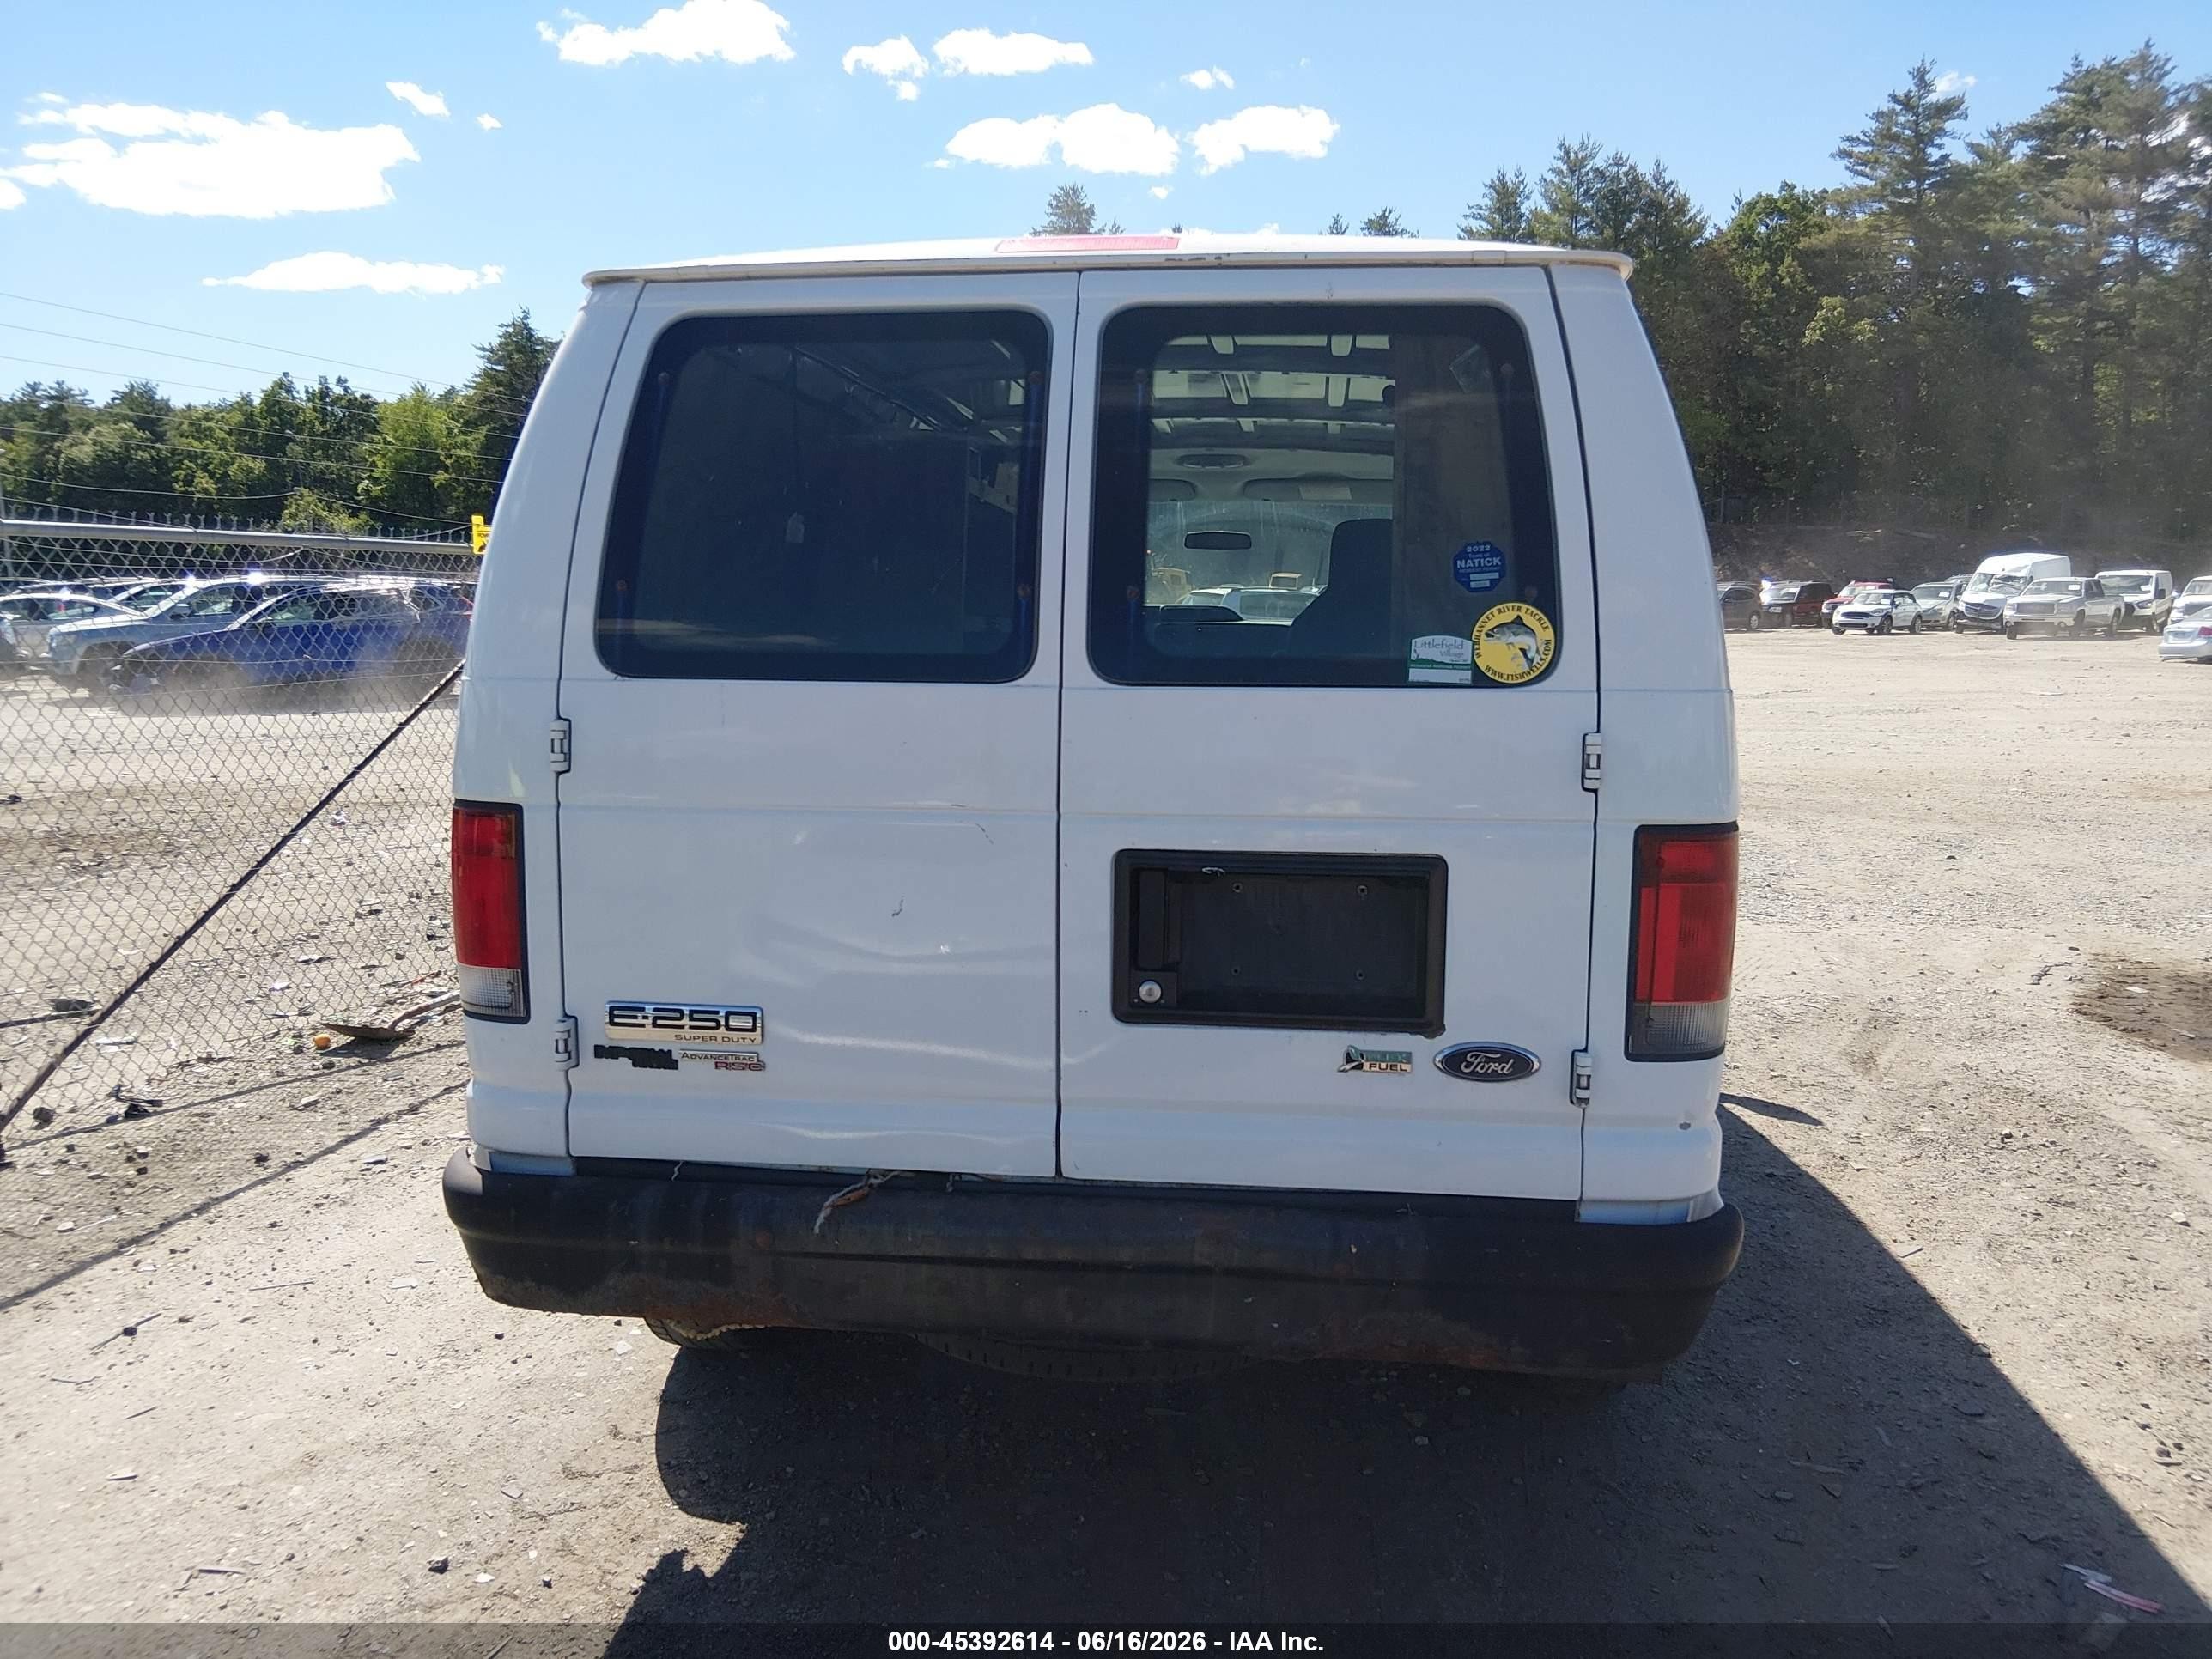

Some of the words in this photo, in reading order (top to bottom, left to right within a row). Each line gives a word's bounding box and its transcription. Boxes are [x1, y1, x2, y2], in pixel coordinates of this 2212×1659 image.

[1466, 544, 1491, 553] 2022
[1456, 556, 1502, 568] NATICK
[1496, 605, 1522, 615] RIVER
[1524, 607, 1550, 632] TACKLE
[1414, 638, 1464, 650] Littlefield
[1485, 639, 1553, 681] WWW.FISHWELLS.COM
[674, 1034, 718, 1043] SUPER
[721, 1036, 757, 1044] DUTY
[714, 1060, 766, 1072] RSC
[1369, 1063, 1408, 1073] FUEL
[1461, 1051, 1515, 1074] Ford
